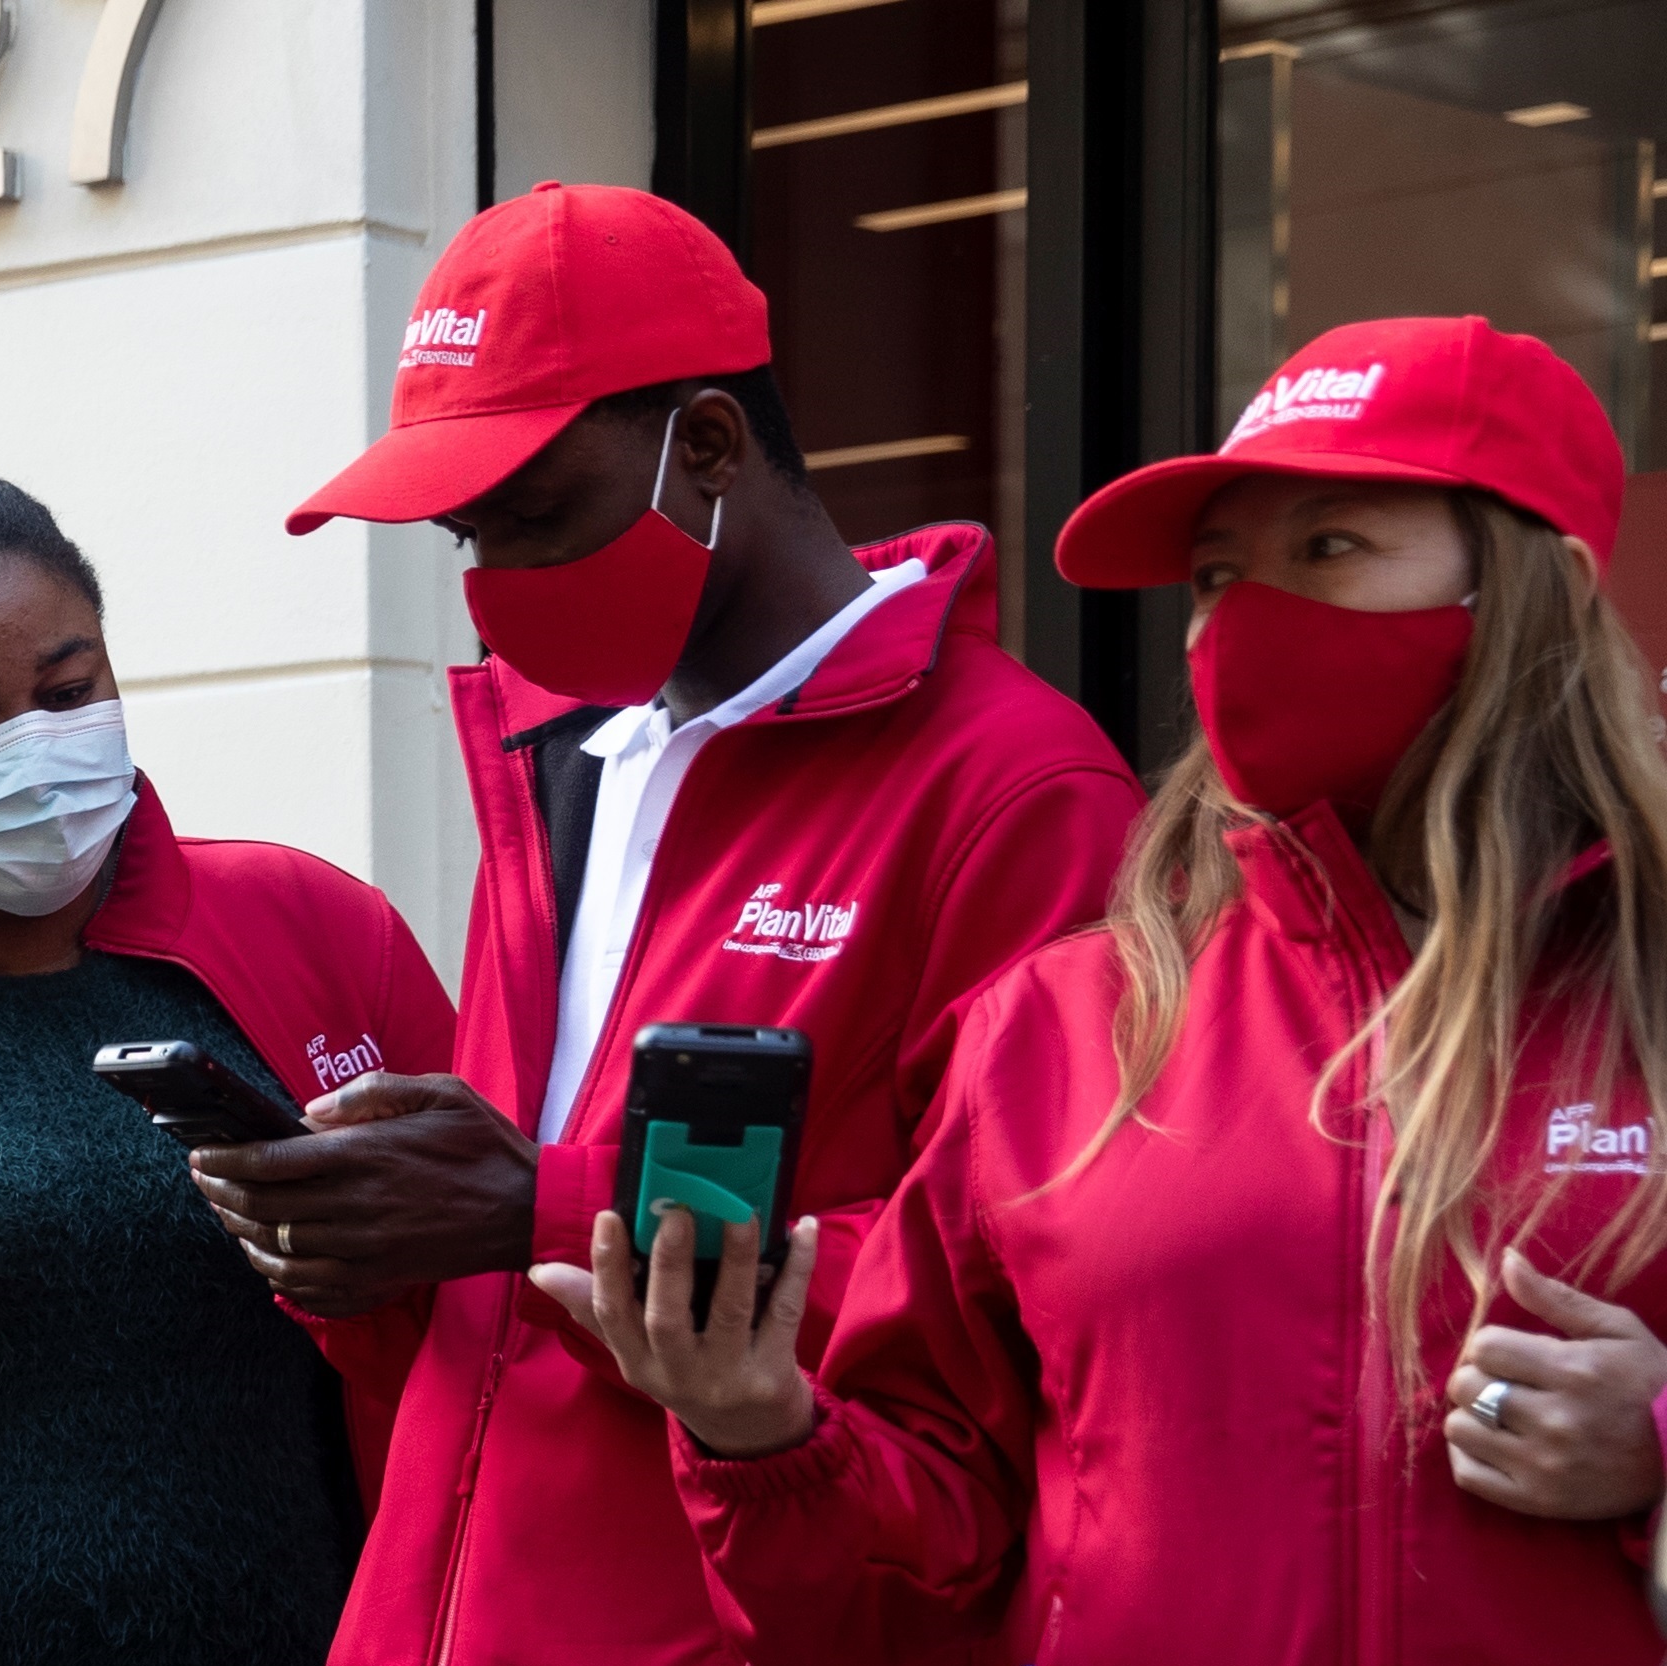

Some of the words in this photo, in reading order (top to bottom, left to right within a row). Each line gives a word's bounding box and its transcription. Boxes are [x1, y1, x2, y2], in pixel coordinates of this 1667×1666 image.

[750, 883, 783, 900] AFP
[732, 900, 858, 942] PlanVital
[306, 1033, 326, 1059] AFP
[1548, 1103, 1595, 1121] AFP
